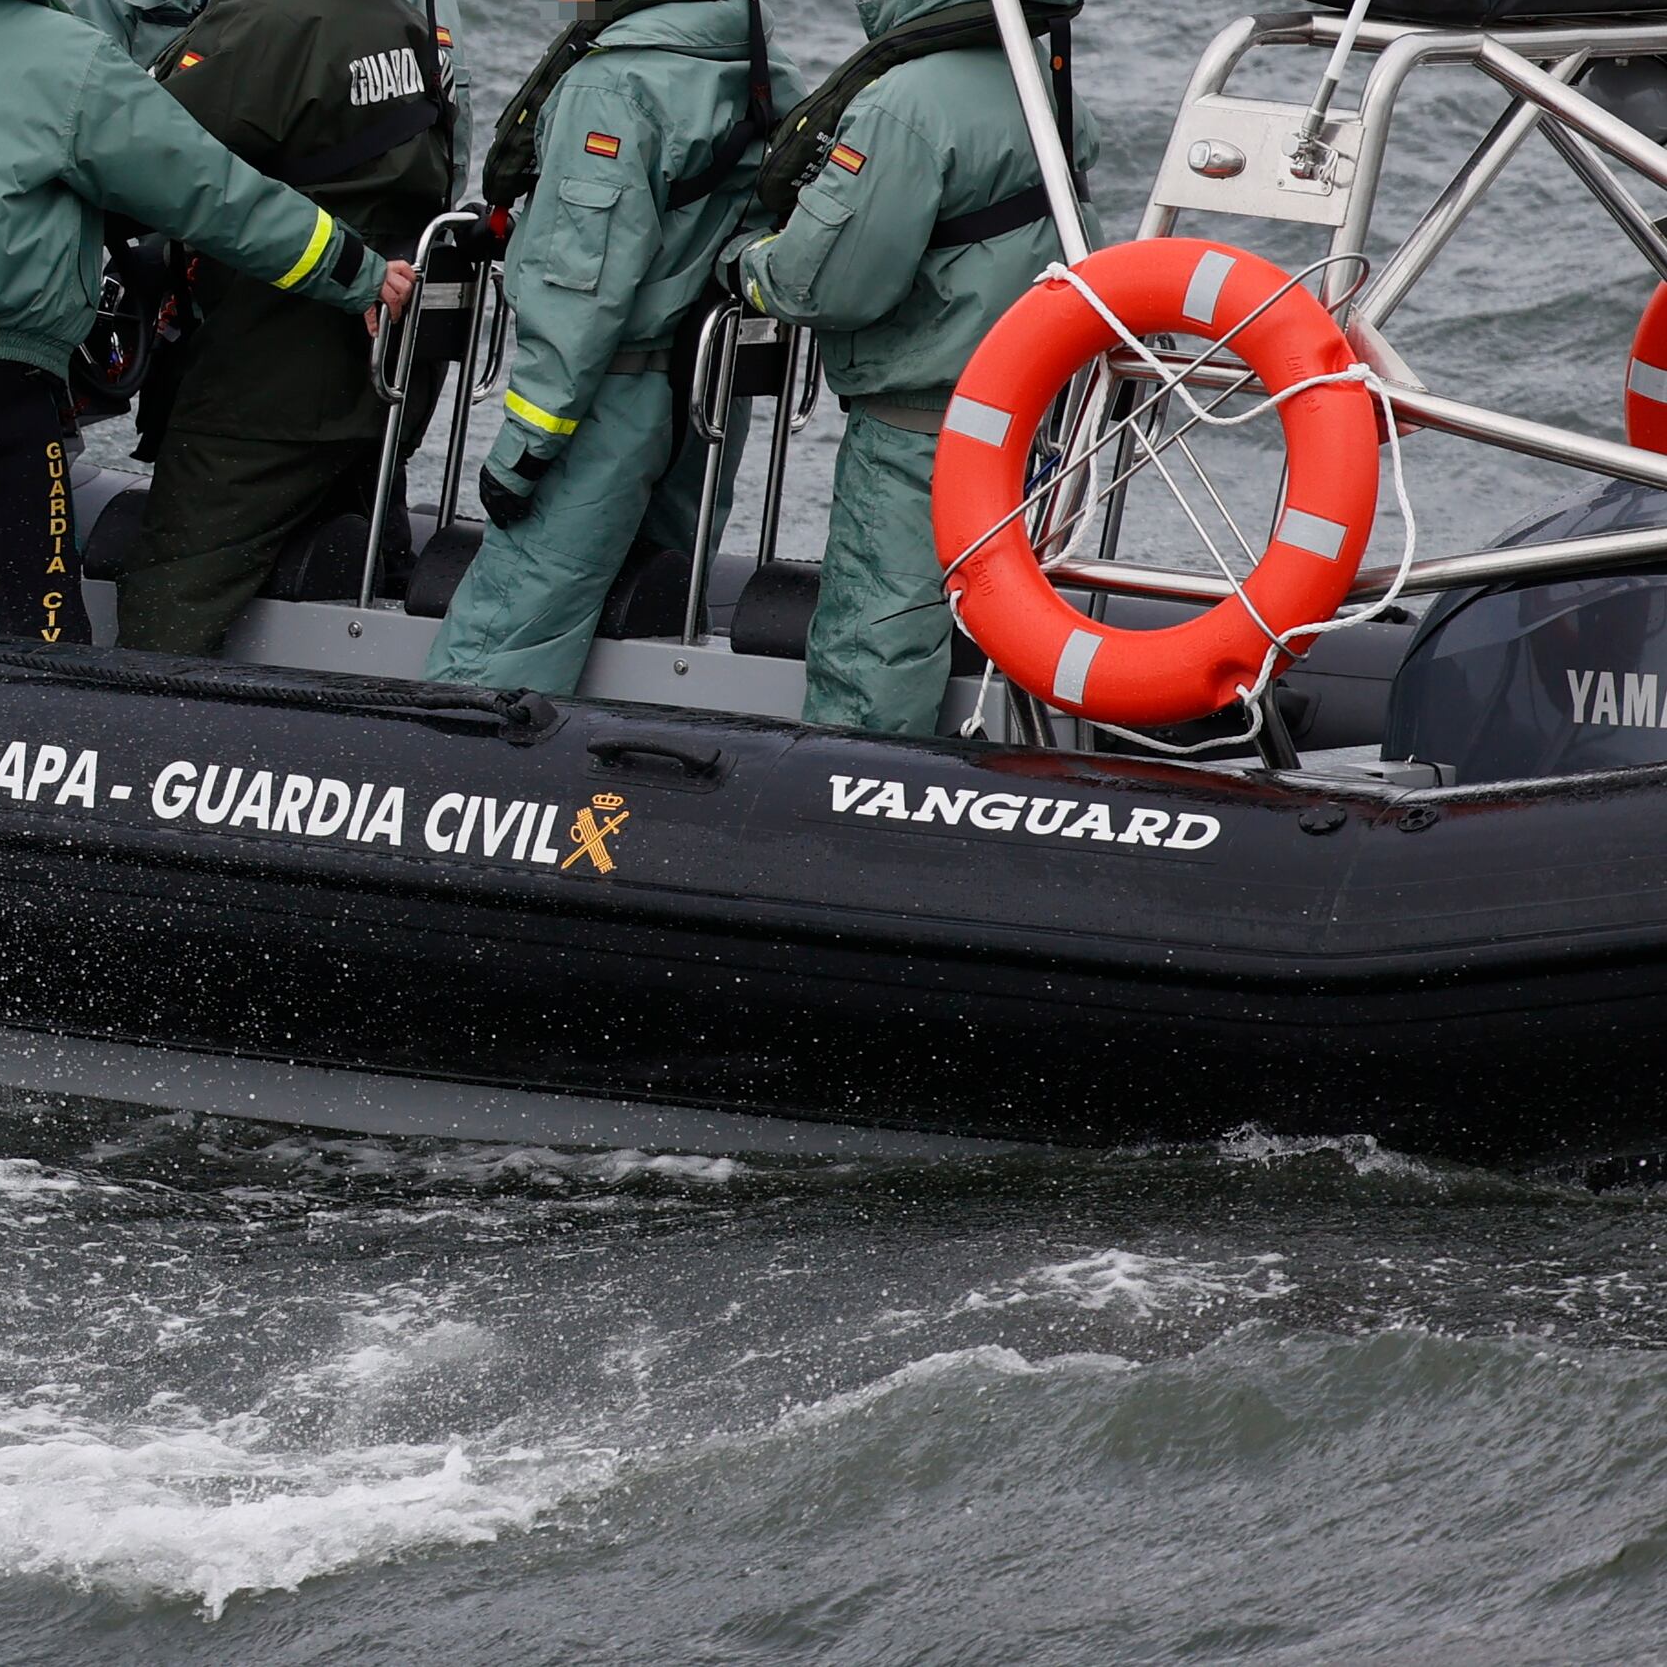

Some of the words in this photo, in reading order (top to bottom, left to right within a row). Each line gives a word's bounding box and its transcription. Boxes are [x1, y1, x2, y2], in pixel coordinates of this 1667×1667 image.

[45, 441, 67, 575] GUARDIA
[40, 591, 63, 643] CIV
[148, 760, 405, 847] GUARDIA
[424, 792, 560, 864] CIVIL
[828, 774, 1221, 850] VANGUARD
